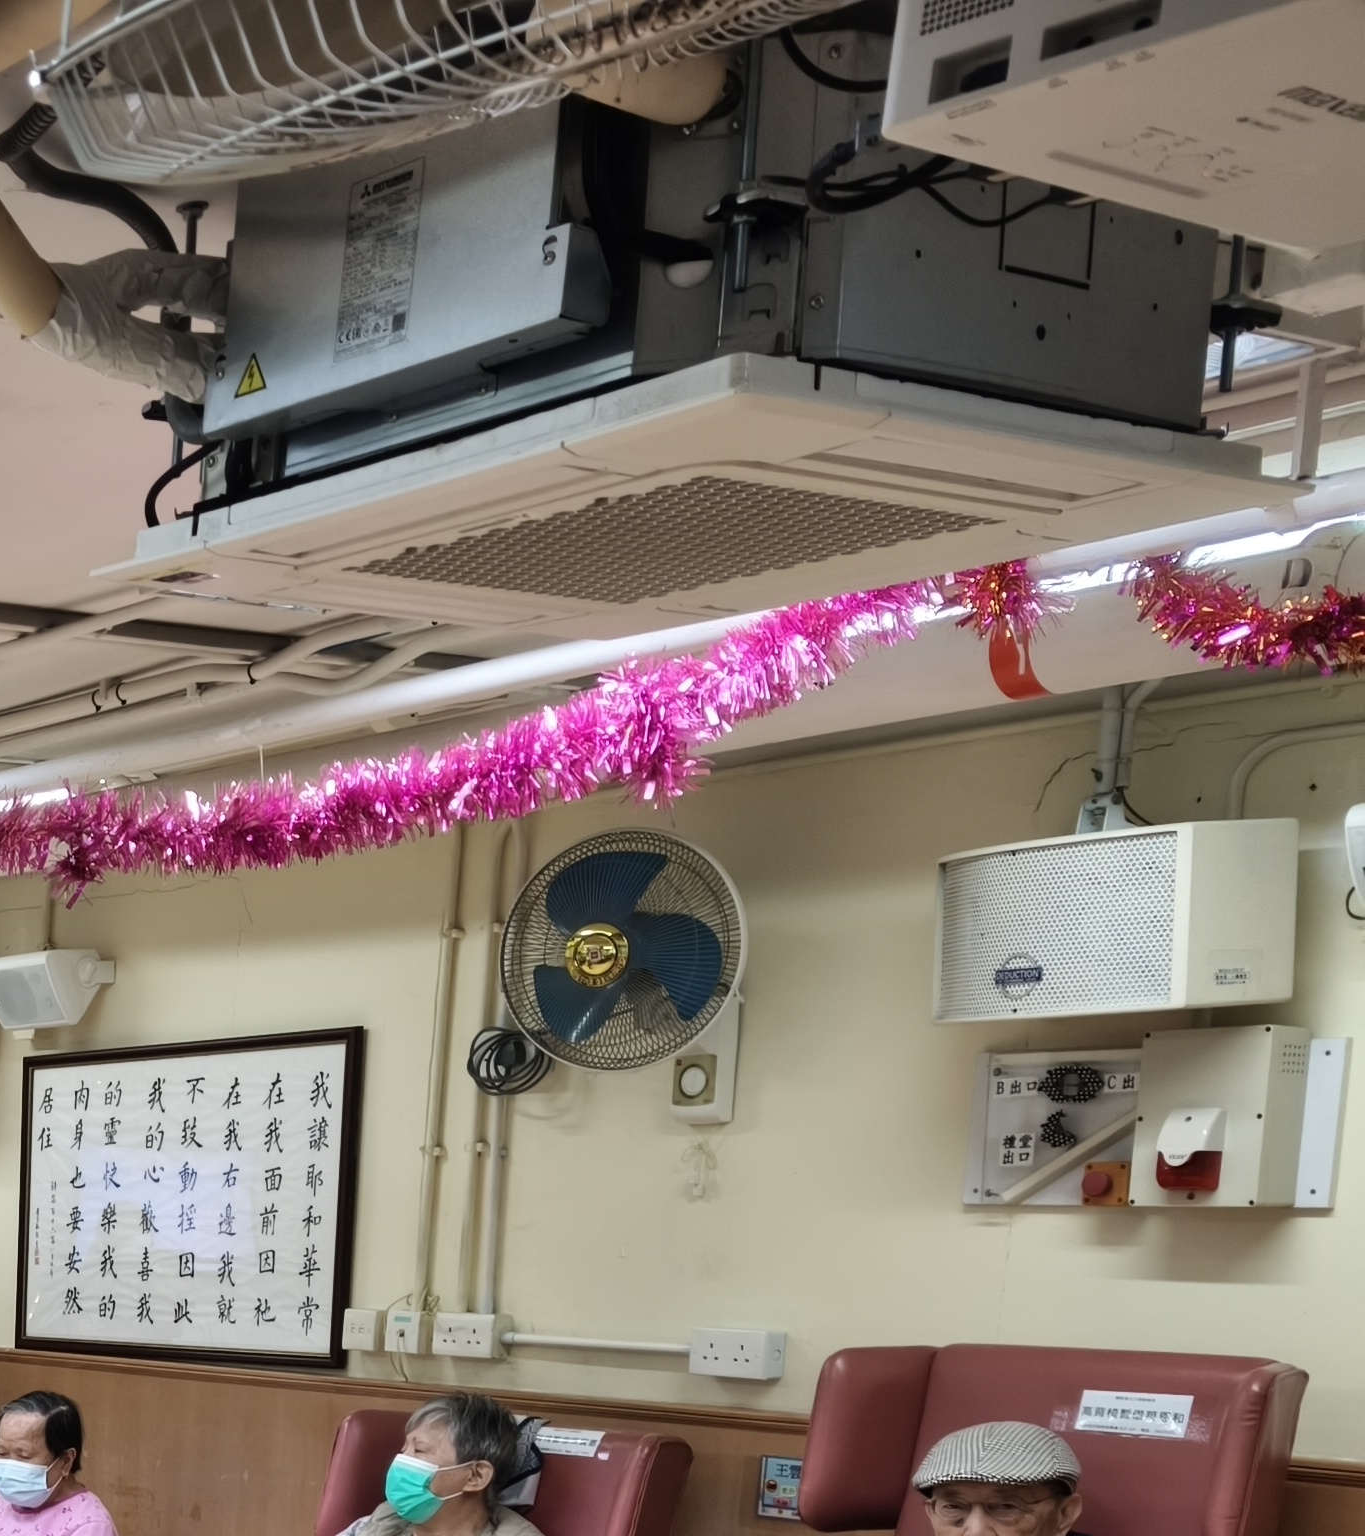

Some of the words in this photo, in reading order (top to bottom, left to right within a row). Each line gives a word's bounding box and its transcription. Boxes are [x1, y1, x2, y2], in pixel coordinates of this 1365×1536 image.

[36, 1087, 54, 1152] 居住
[64, 1079, 90, 1315] 肉身也要安然
[98, 1080, 122, 1319] 的靈快樂我的
[253, 1072, 285, 1327] 在我面前因祂
[996, 1081, 1005, 1095] B
[1010, 1079, 1038, 1094] 出口
[1003, 1134, 1033, 1149] 禮堂
[1003, 1150, 1030, 1165] 出口
[1107, 1075, 1118, 1089] C
[136, 1077, 166, 1325] 我的心歡喜我
[217, 1077, 243, 1325] 在我右邊我就
[298, 1070, 332, 1336] 我讓耶和華常
